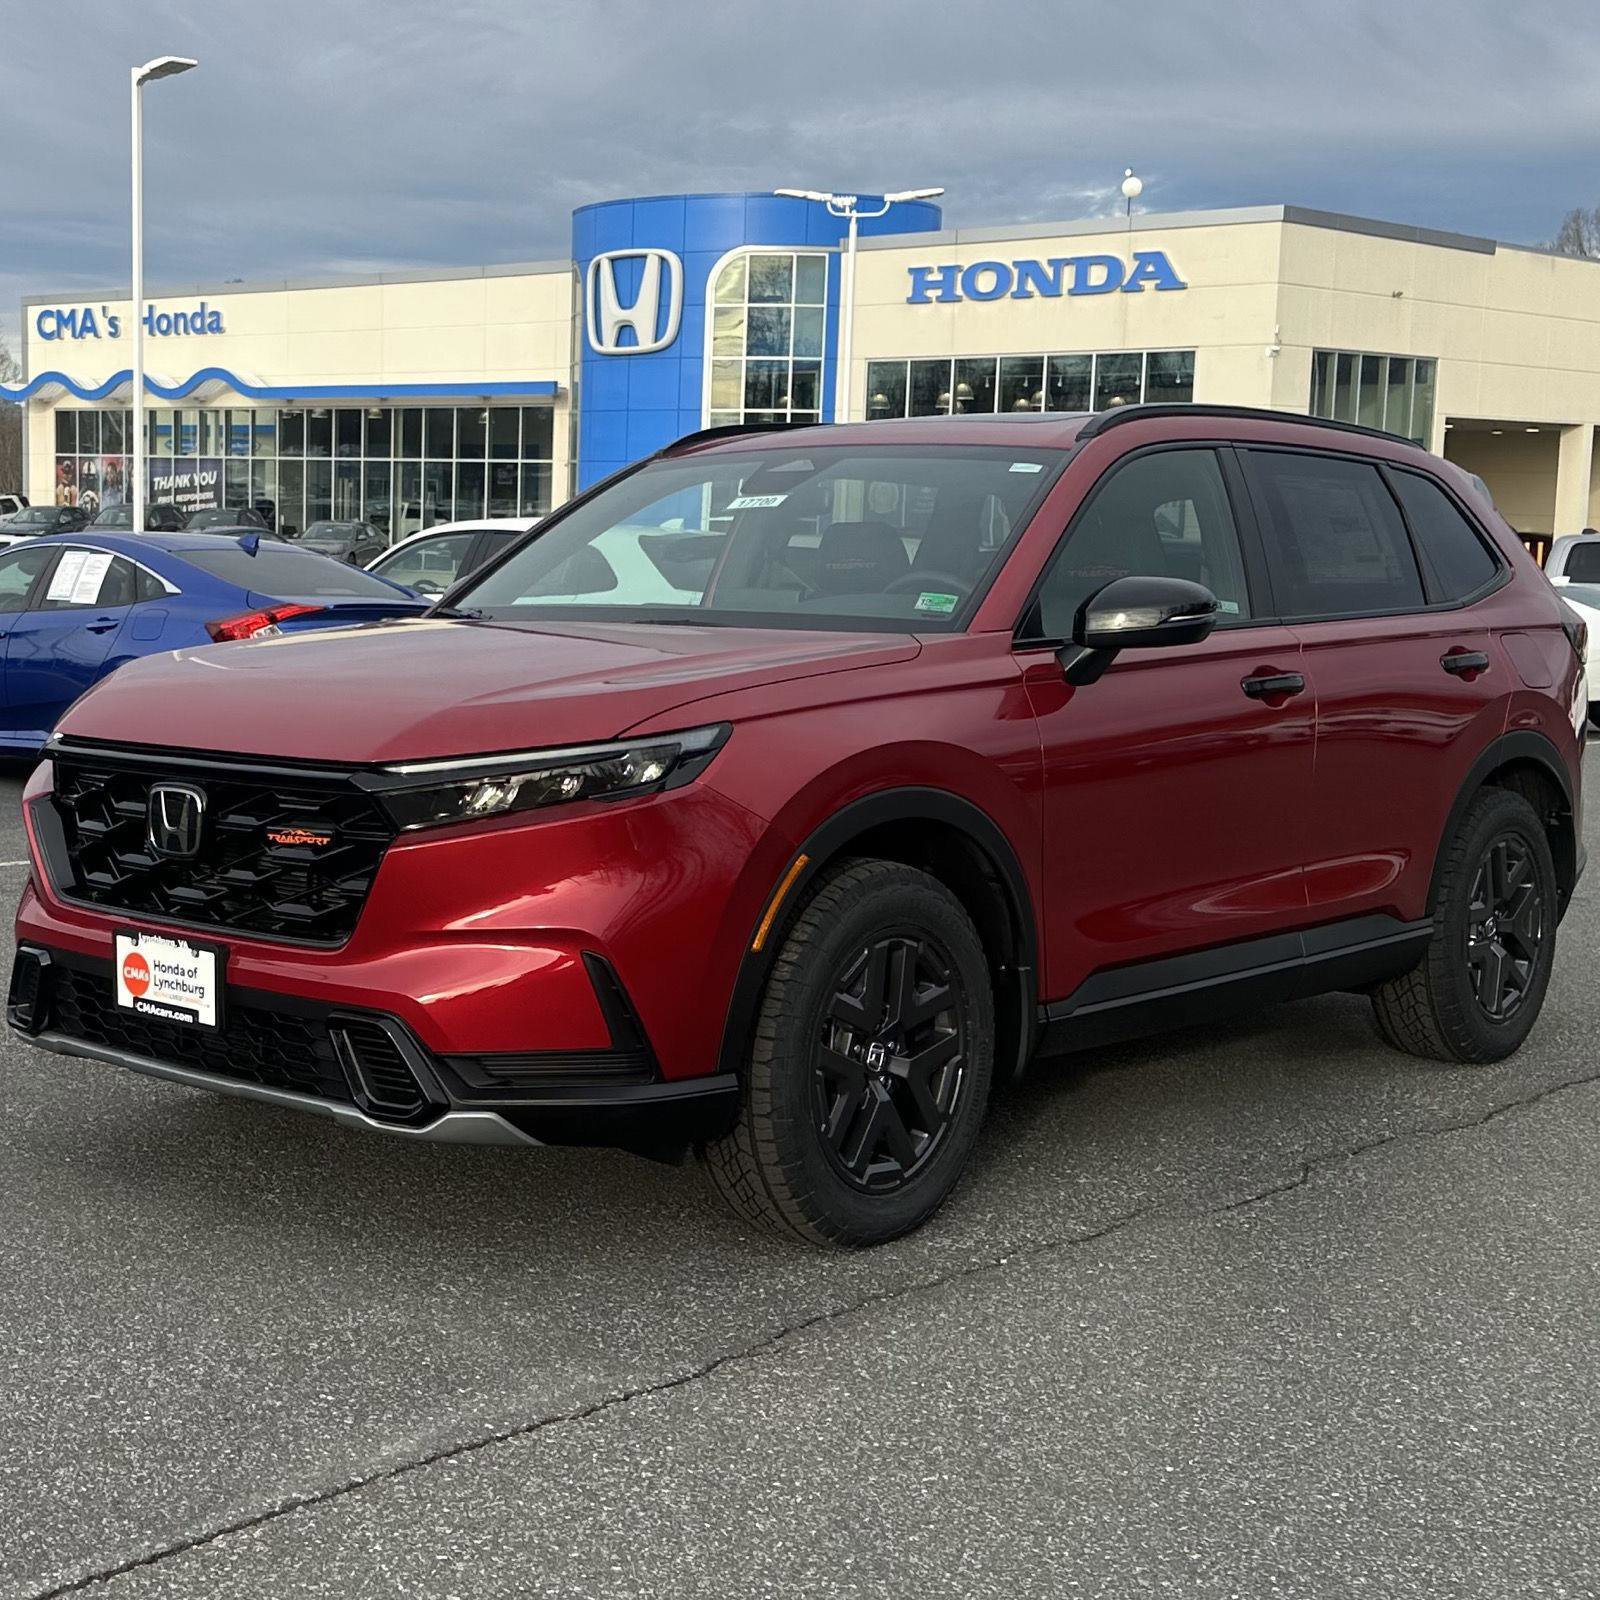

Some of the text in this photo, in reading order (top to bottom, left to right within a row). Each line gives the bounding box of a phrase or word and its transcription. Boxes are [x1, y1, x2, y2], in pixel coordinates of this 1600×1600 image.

[907, 251, 1188, 304] HONDA
[37, 305, 121, 341] CMA's
[153, 471, 217, 490] THANK YOU
[267, 833, 330, 845] TRAILSPORT
[154, 960, 198, 979] Honda of
[154, 974, 204, 998] Lynchburg
[136, 1002, 193, 1023] CMAcars.com
